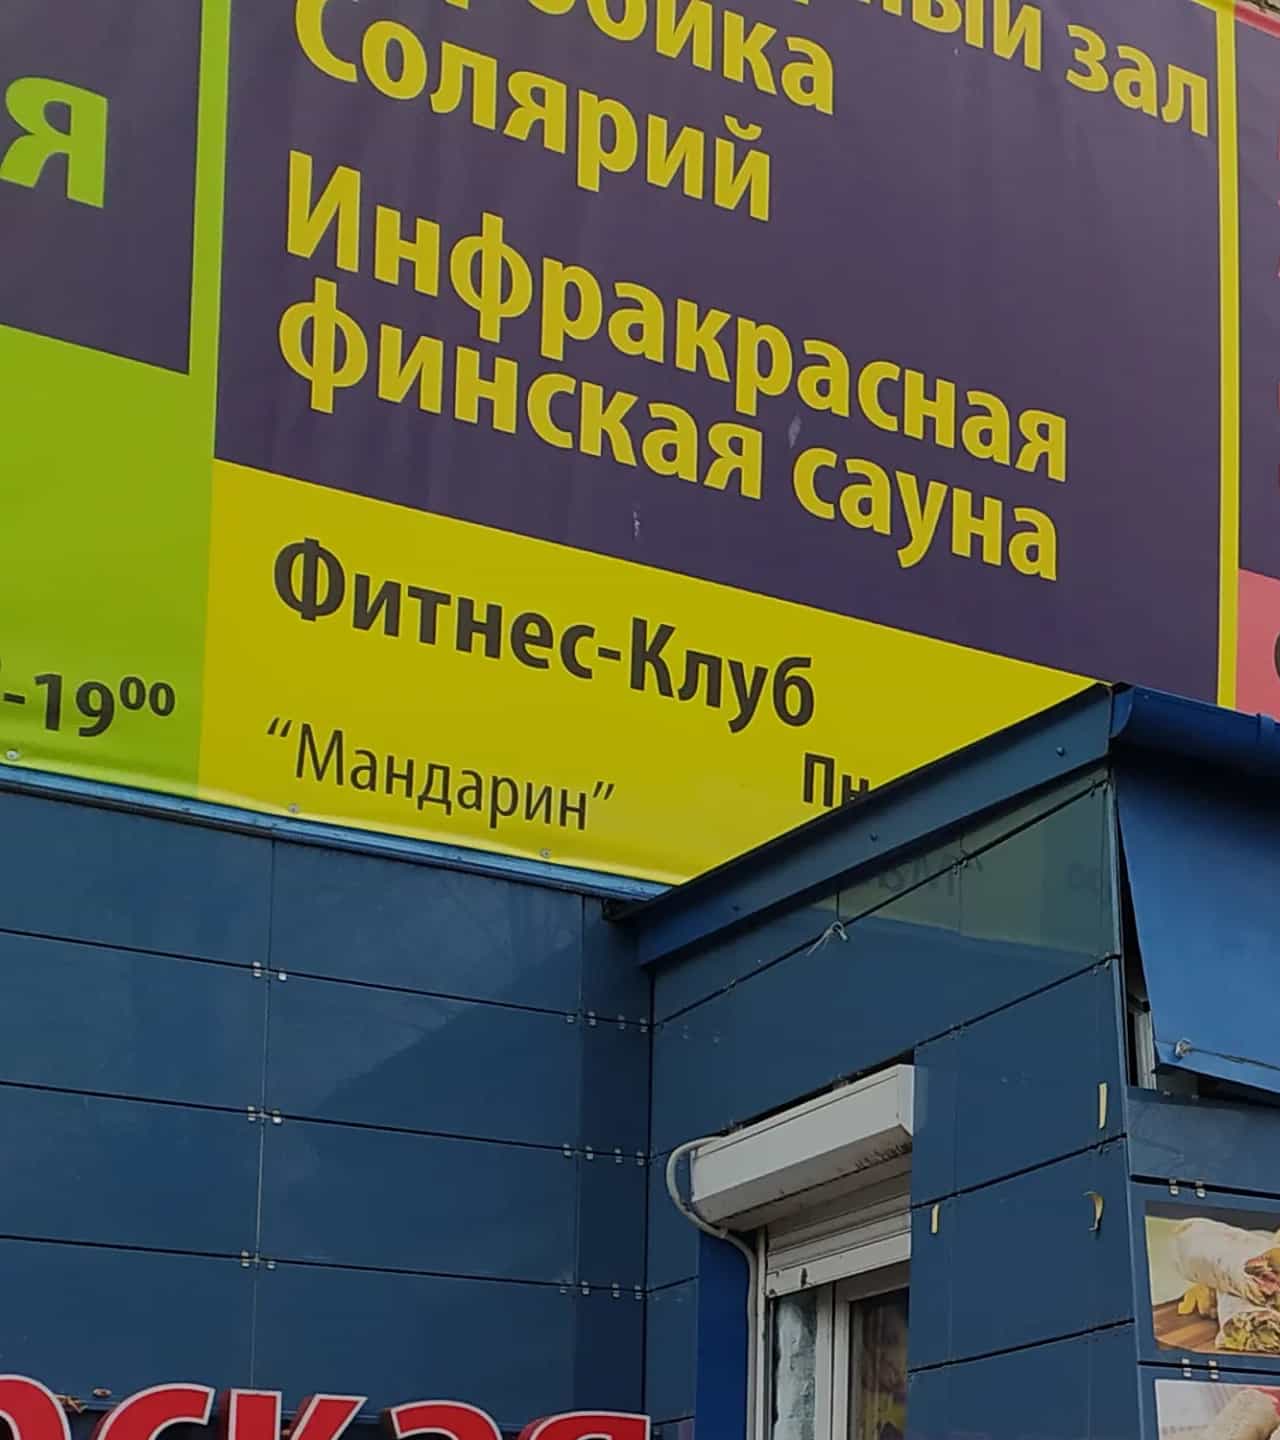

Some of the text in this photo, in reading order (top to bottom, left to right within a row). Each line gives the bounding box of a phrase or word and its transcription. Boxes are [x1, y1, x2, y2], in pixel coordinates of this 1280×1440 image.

[294, 0, 772, 222] Солярий
[1066, 24, 1209, 137] зал
[287, 150, 1068, 483] Инфракрасная
[278, 278, 1058, 582] финская сауна
[272, 537, 815, 733] Фитнес-Клуб
